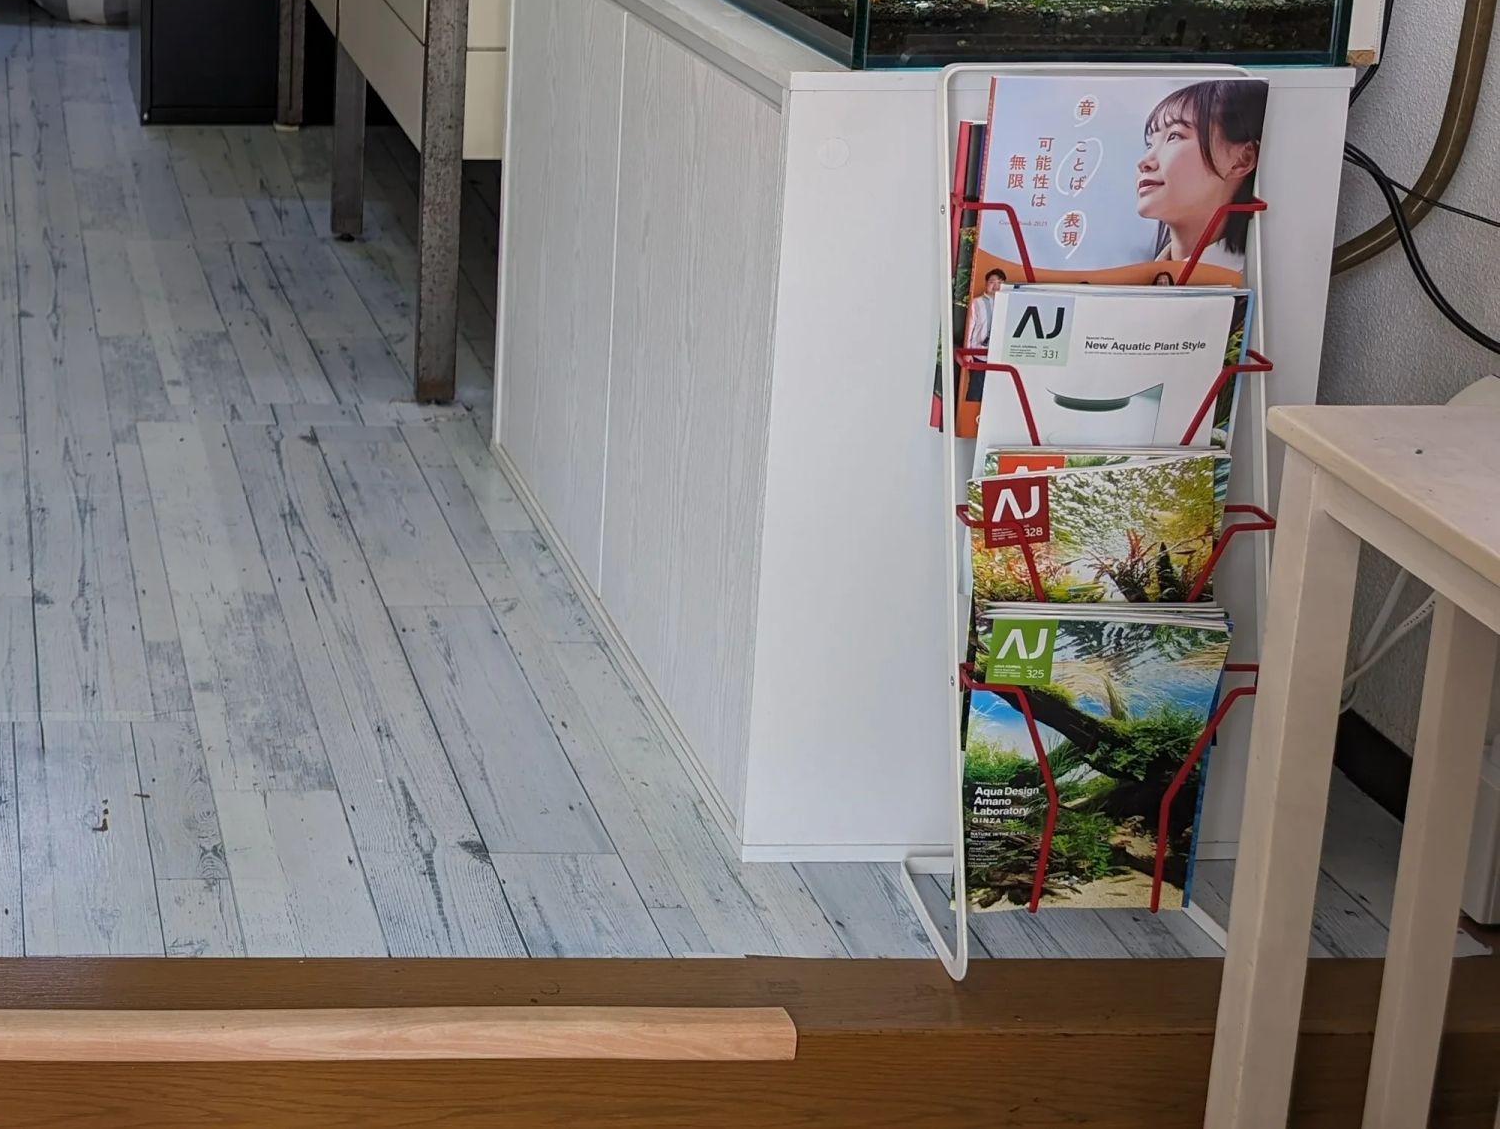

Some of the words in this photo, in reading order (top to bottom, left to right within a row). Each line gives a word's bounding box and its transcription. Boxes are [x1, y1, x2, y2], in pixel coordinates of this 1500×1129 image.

[1078, 99, 1095, 116] 音
[1007, 155, 1027, 190] 無限
[1031, 137, 1055, 208] 可能性は
[1068, 141, 1088, 191] ことば
[1061, 213, 1080, 247] 表現
[1012, 306, 1065, 339] AJ
[1041, 350, 1059, 359] 331
[1085, 341, 1108, 350] New
[1111, 341, 1151, 352] Aquatic
[1154, 342, 1179, 351] Plant
[1182, 341, 1206, 351] Style
[991, 486, 1040, 522] AJ
[1023, 527, 1043, 537] 328
[996, 628, 1048, 659] AJ
[1026, 670, 1045, 678] 325
[975, 787, 1003, 797] Aqua
[1004, 787, 1039, 796] Design
[974, 797, 1012, 805] Amano
[973, 806, 1030, 816] Laboratory
